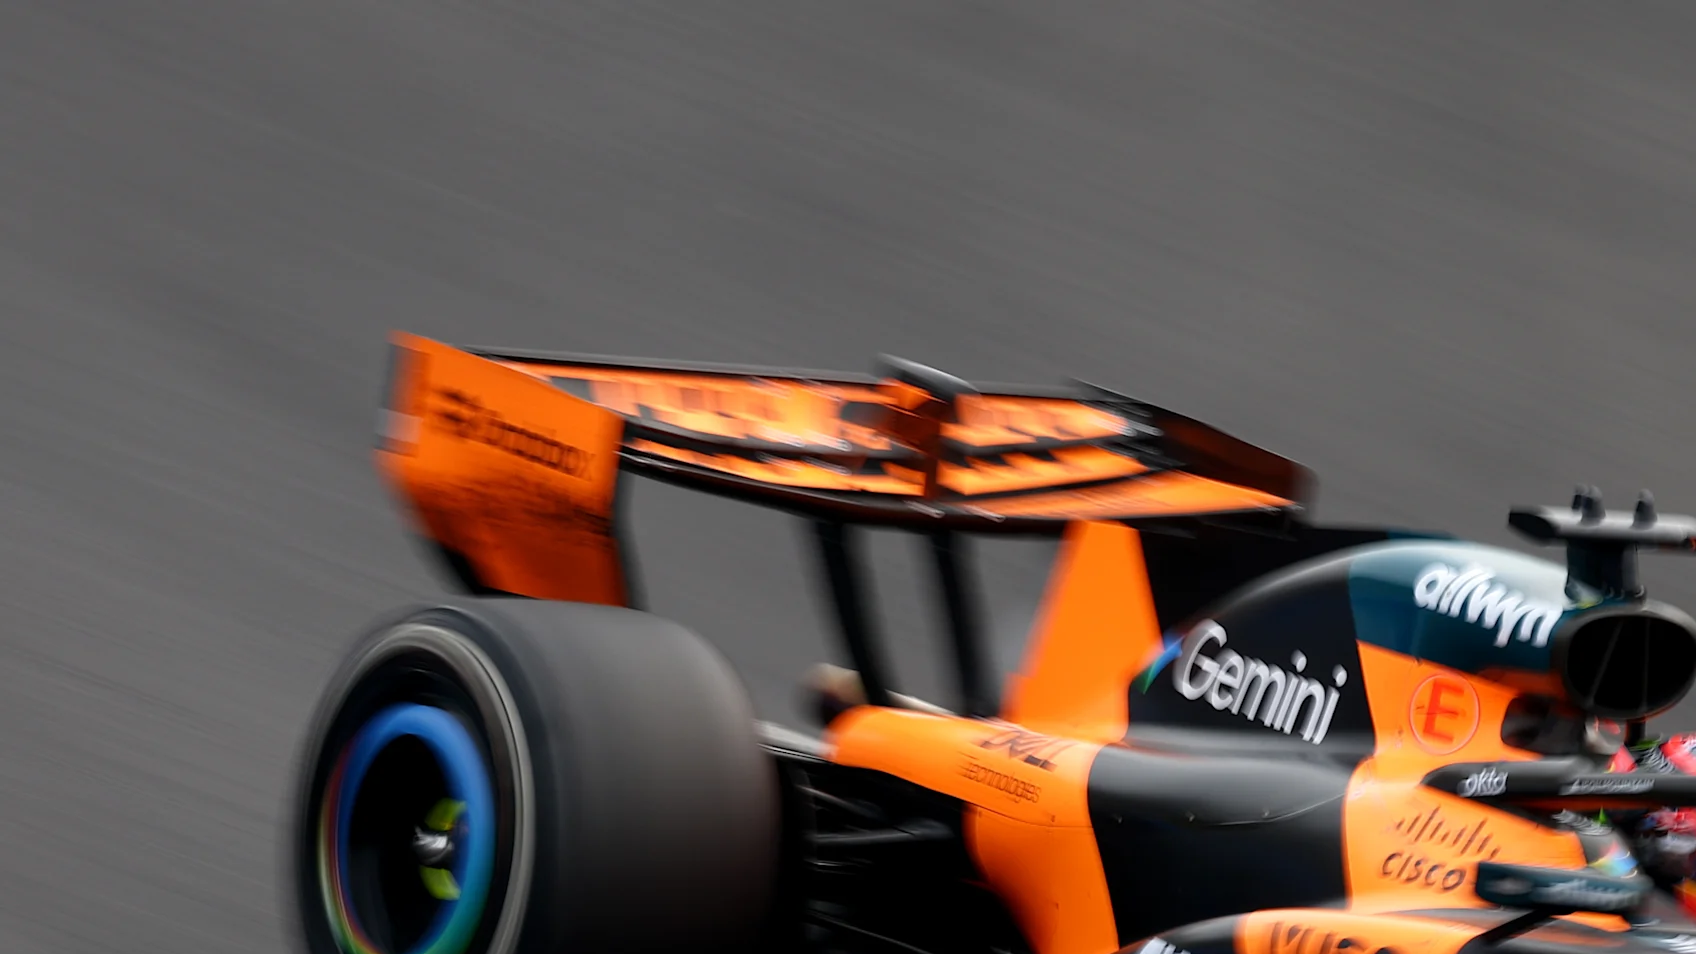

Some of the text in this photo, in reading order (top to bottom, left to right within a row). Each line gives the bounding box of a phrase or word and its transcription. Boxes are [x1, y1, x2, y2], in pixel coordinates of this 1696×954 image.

[1414, 562, 1563, 648] allwyn
[1173, 618, 1348, 746] Gemini
[1423, 678, 1464, 744] E
[1459, 767, 1508, 797] okta
